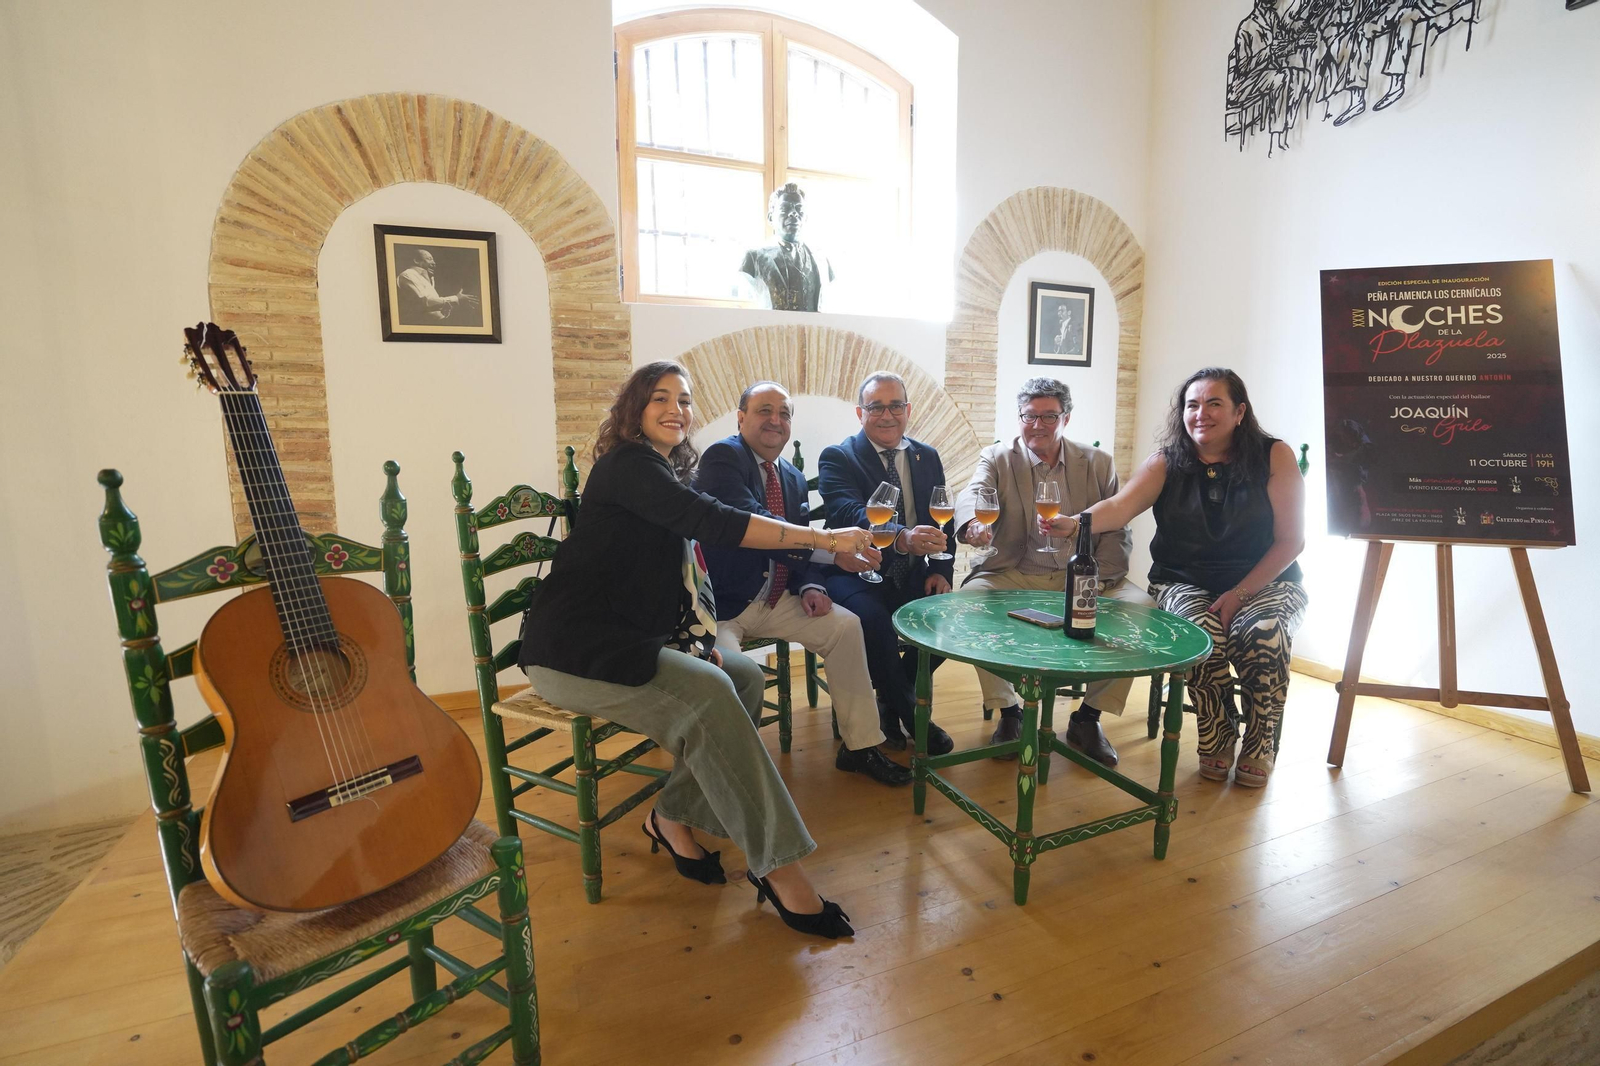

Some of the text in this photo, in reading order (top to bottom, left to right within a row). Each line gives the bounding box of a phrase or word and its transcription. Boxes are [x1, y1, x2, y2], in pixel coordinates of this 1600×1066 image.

[1368, 288, 1501, 301] PEÑA FLAMENCA LOS CERNÍCALOS
[1353, 309, 1364, 328] XXXV
[1369, 330, 1505, 365] Plazuela
[1390, 405, 1468, 419] JOAQUÍN
[1433, 417, 1492, 445] Grilo
